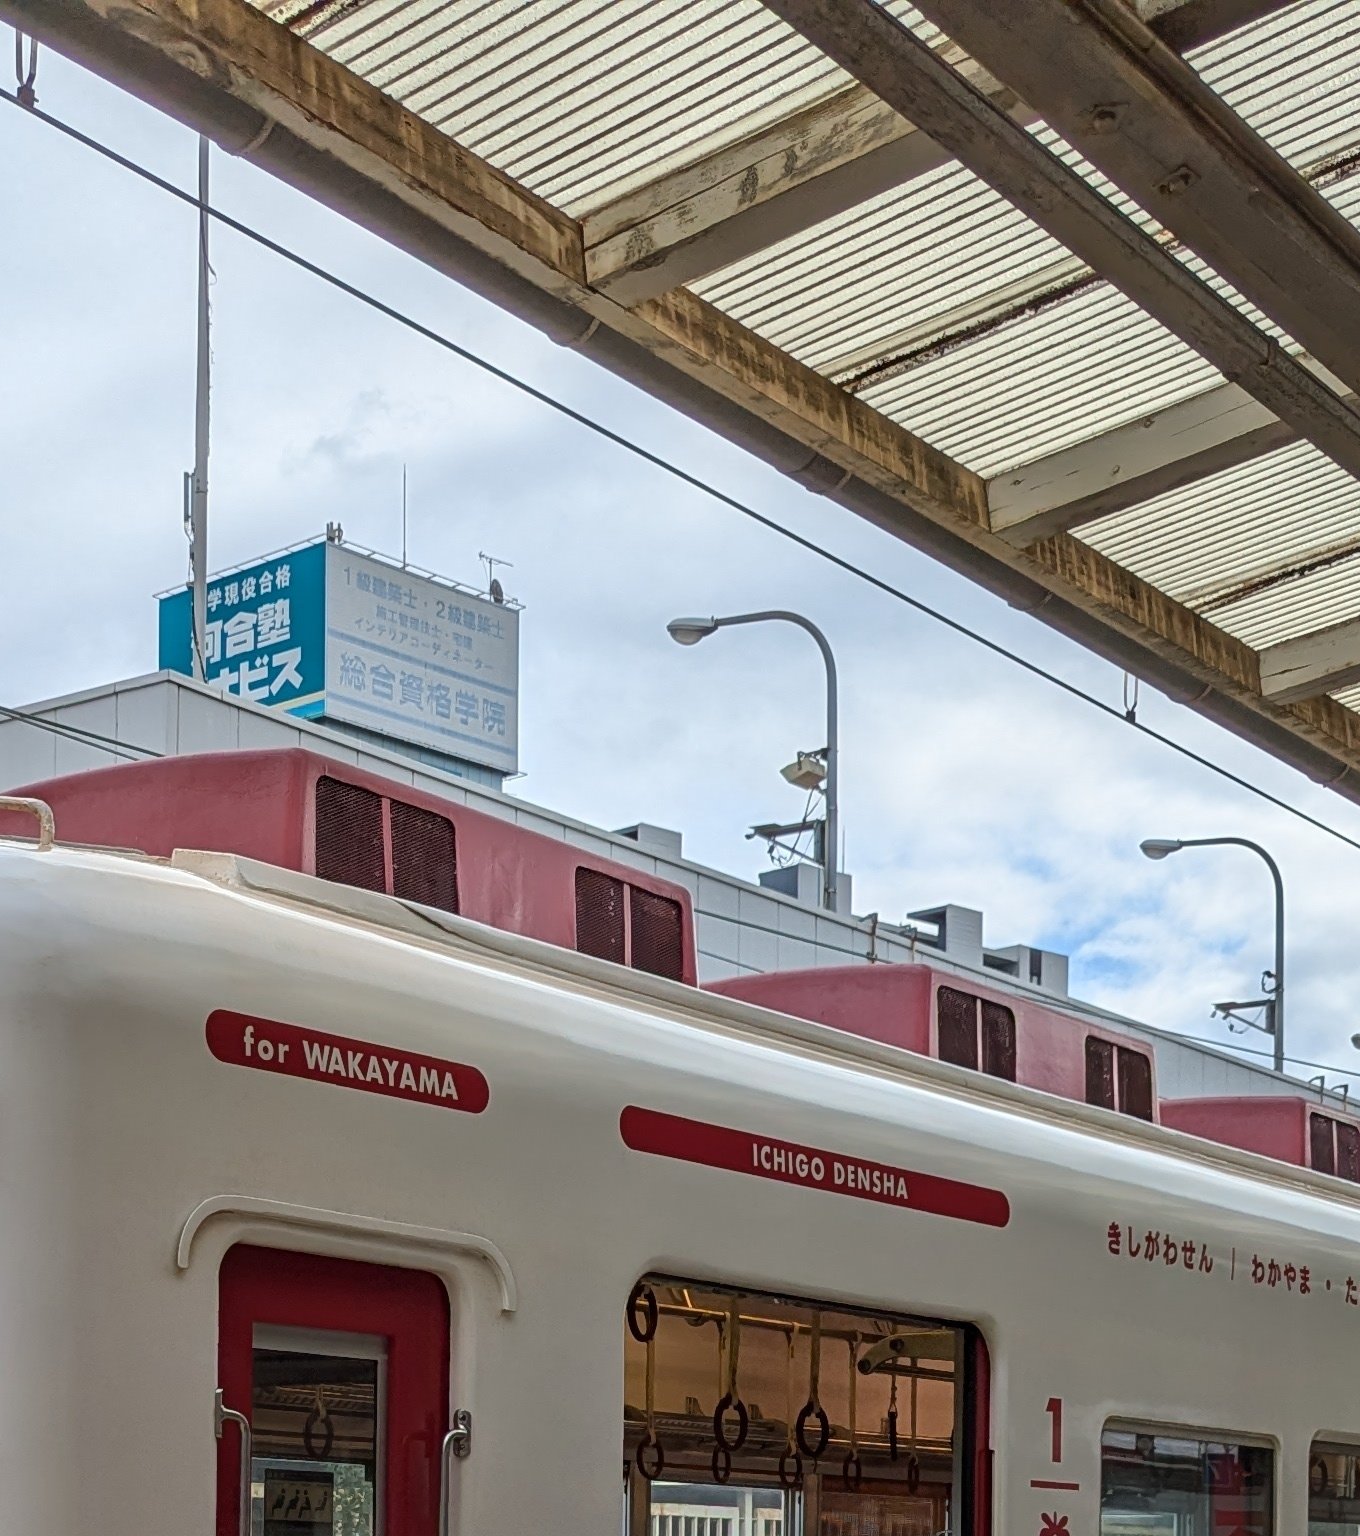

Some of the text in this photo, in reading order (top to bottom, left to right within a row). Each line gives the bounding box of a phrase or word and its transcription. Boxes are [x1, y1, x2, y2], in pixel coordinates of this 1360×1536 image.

[191, 564, 291, 612] 学現役合格
[340, 650, 506, 737] 総合資格学院
[243, 1026, 459, 1102] for WAKAYAMA
[752, 1143, 910, 1200] ICHIGO DENSHA
[1107, 1220, 1214, 1275] きしがわせん
[1251, 1254, 1311, 1295] わかやま
[1045, 1397, 1062, 1463] 1
